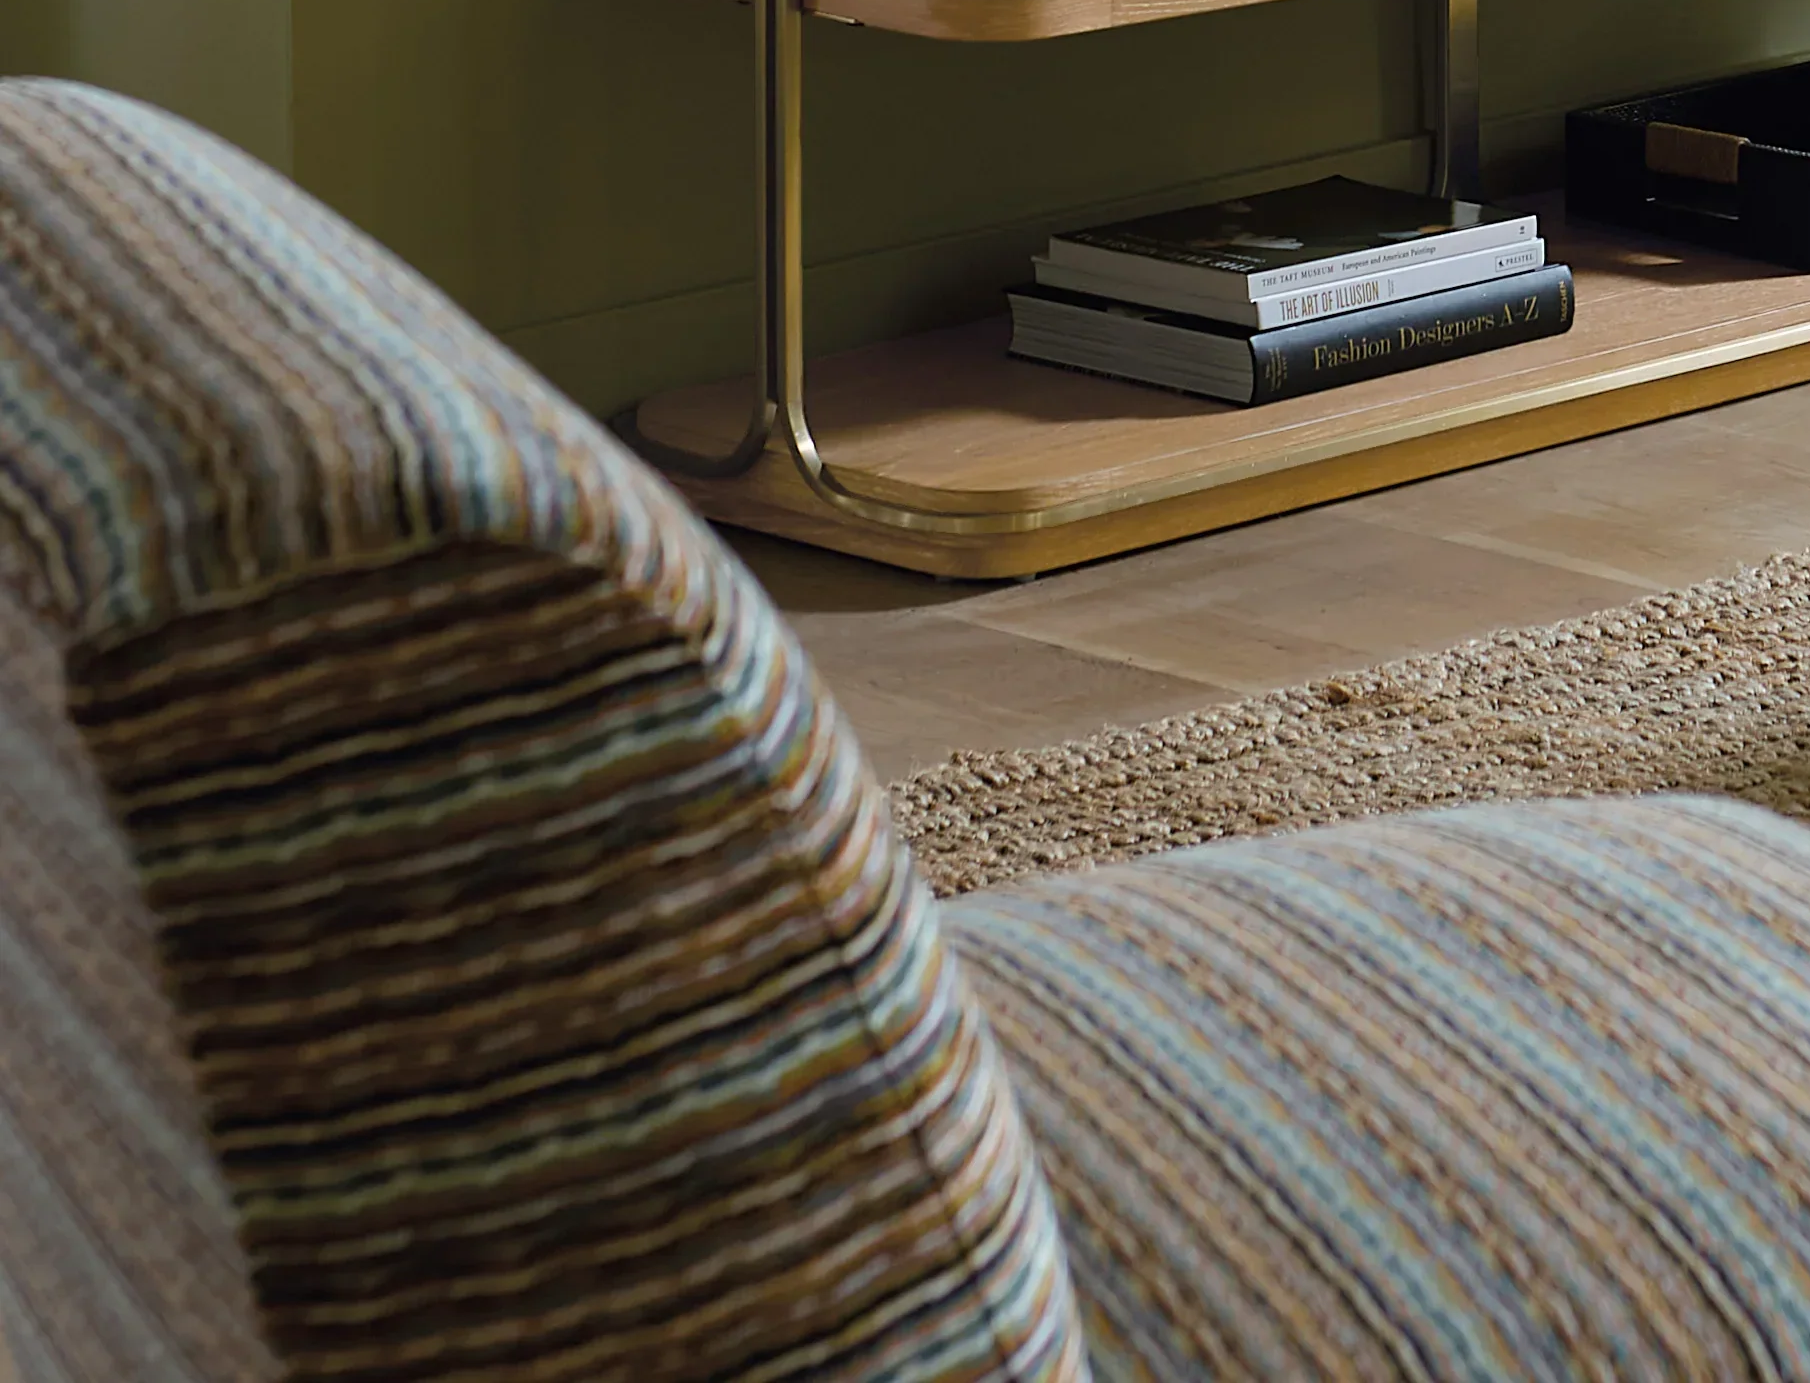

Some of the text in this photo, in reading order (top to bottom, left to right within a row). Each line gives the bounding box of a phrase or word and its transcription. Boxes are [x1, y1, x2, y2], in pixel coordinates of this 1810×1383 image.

[1342, 260, 1369, 271] European
[1370, 255, 1381, 265] and
[1506, 253, 1533, 264] PRESTEL
[1262, 265, 1335, 287] THE TAFT MUSEUM
[1280, 298, 1299, 321] THE
[1301, 292, 1319, 317] ART
[1322, 291, 1333, 312] OF
[1336, 281, 1379, 309] ILLUSION
[1314, 337, 1391, 370] Fashion
[1400, 314, 1494, 350] Designers
